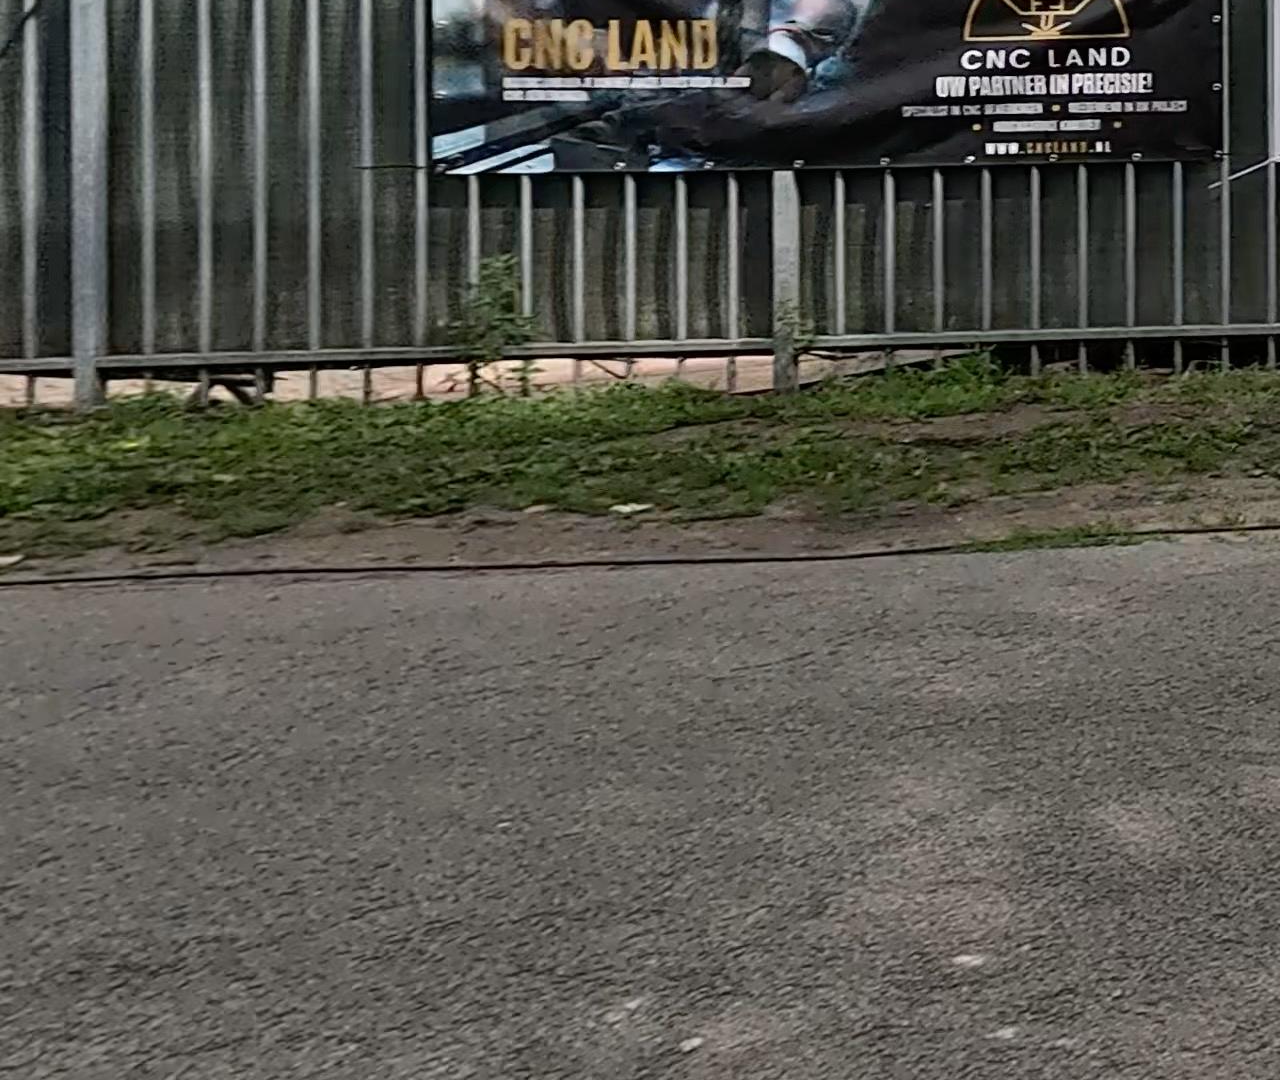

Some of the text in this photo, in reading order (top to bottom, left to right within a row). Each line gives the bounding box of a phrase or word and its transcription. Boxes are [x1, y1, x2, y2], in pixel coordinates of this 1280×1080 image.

[503, 18, 719, 71] CNC LAND
[960, 46, 1131, 70] CNC LAND
[935, 72, 1154, 97] UW PARTNER IN PRECISIE!
